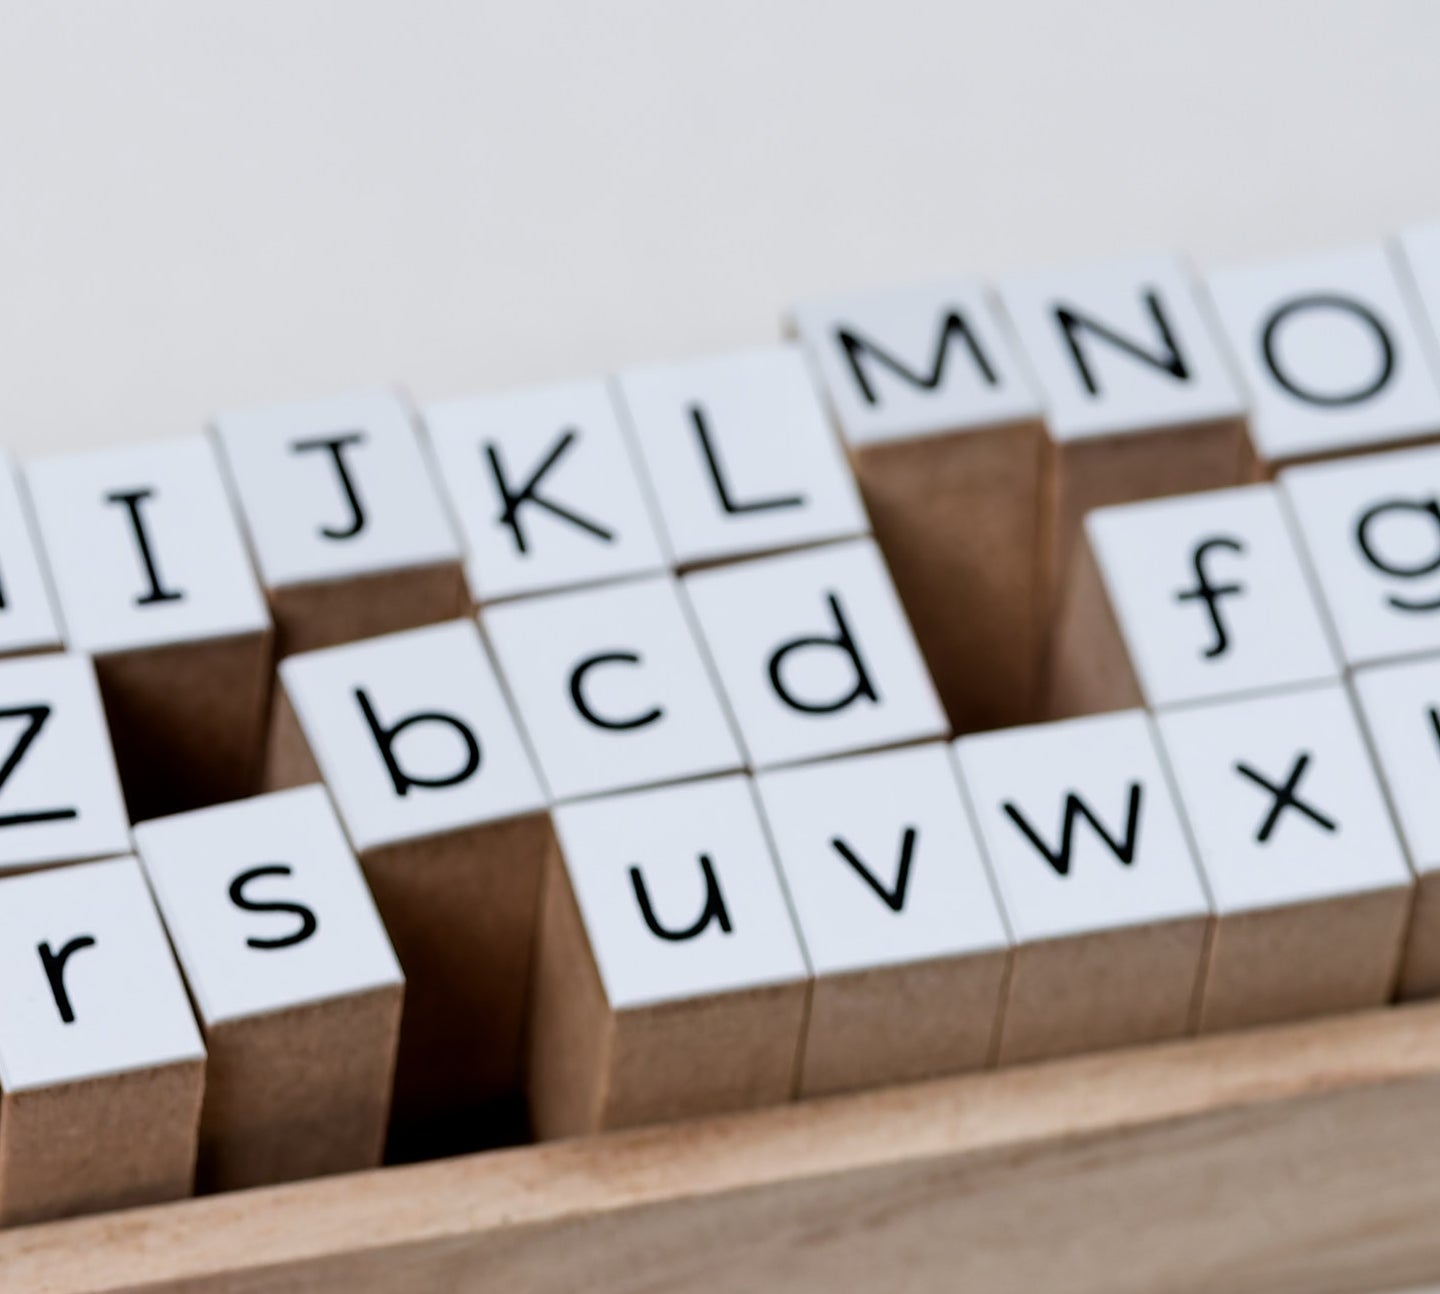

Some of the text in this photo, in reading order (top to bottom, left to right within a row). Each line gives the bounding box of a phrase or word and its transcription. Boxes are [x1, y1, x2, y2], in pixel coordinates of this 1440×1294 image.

[108, 490, 182, 606] I
[295, 435, 366, 540] J
[486, 432, 612, 554] K
[691, 408, 802, 515] L
[836, 310, 997, 406] M
[1054, 292, 1191, 396] N
[1261, 297, 1396, 406] O
[355, 688, 481, 797] b
[568, 652, 663, 732] c
[767, 592, 879, 716] d
[1178, 538, 1242, 659] f
[37, 936, 96, 1024] r
[228, 865, 317, 950] s
[629, 854, 733, 942] u
[832, 827, 917, 913] v
[1003, 783, 1142, 877] w
[1236, 754, 1336, 843] x
